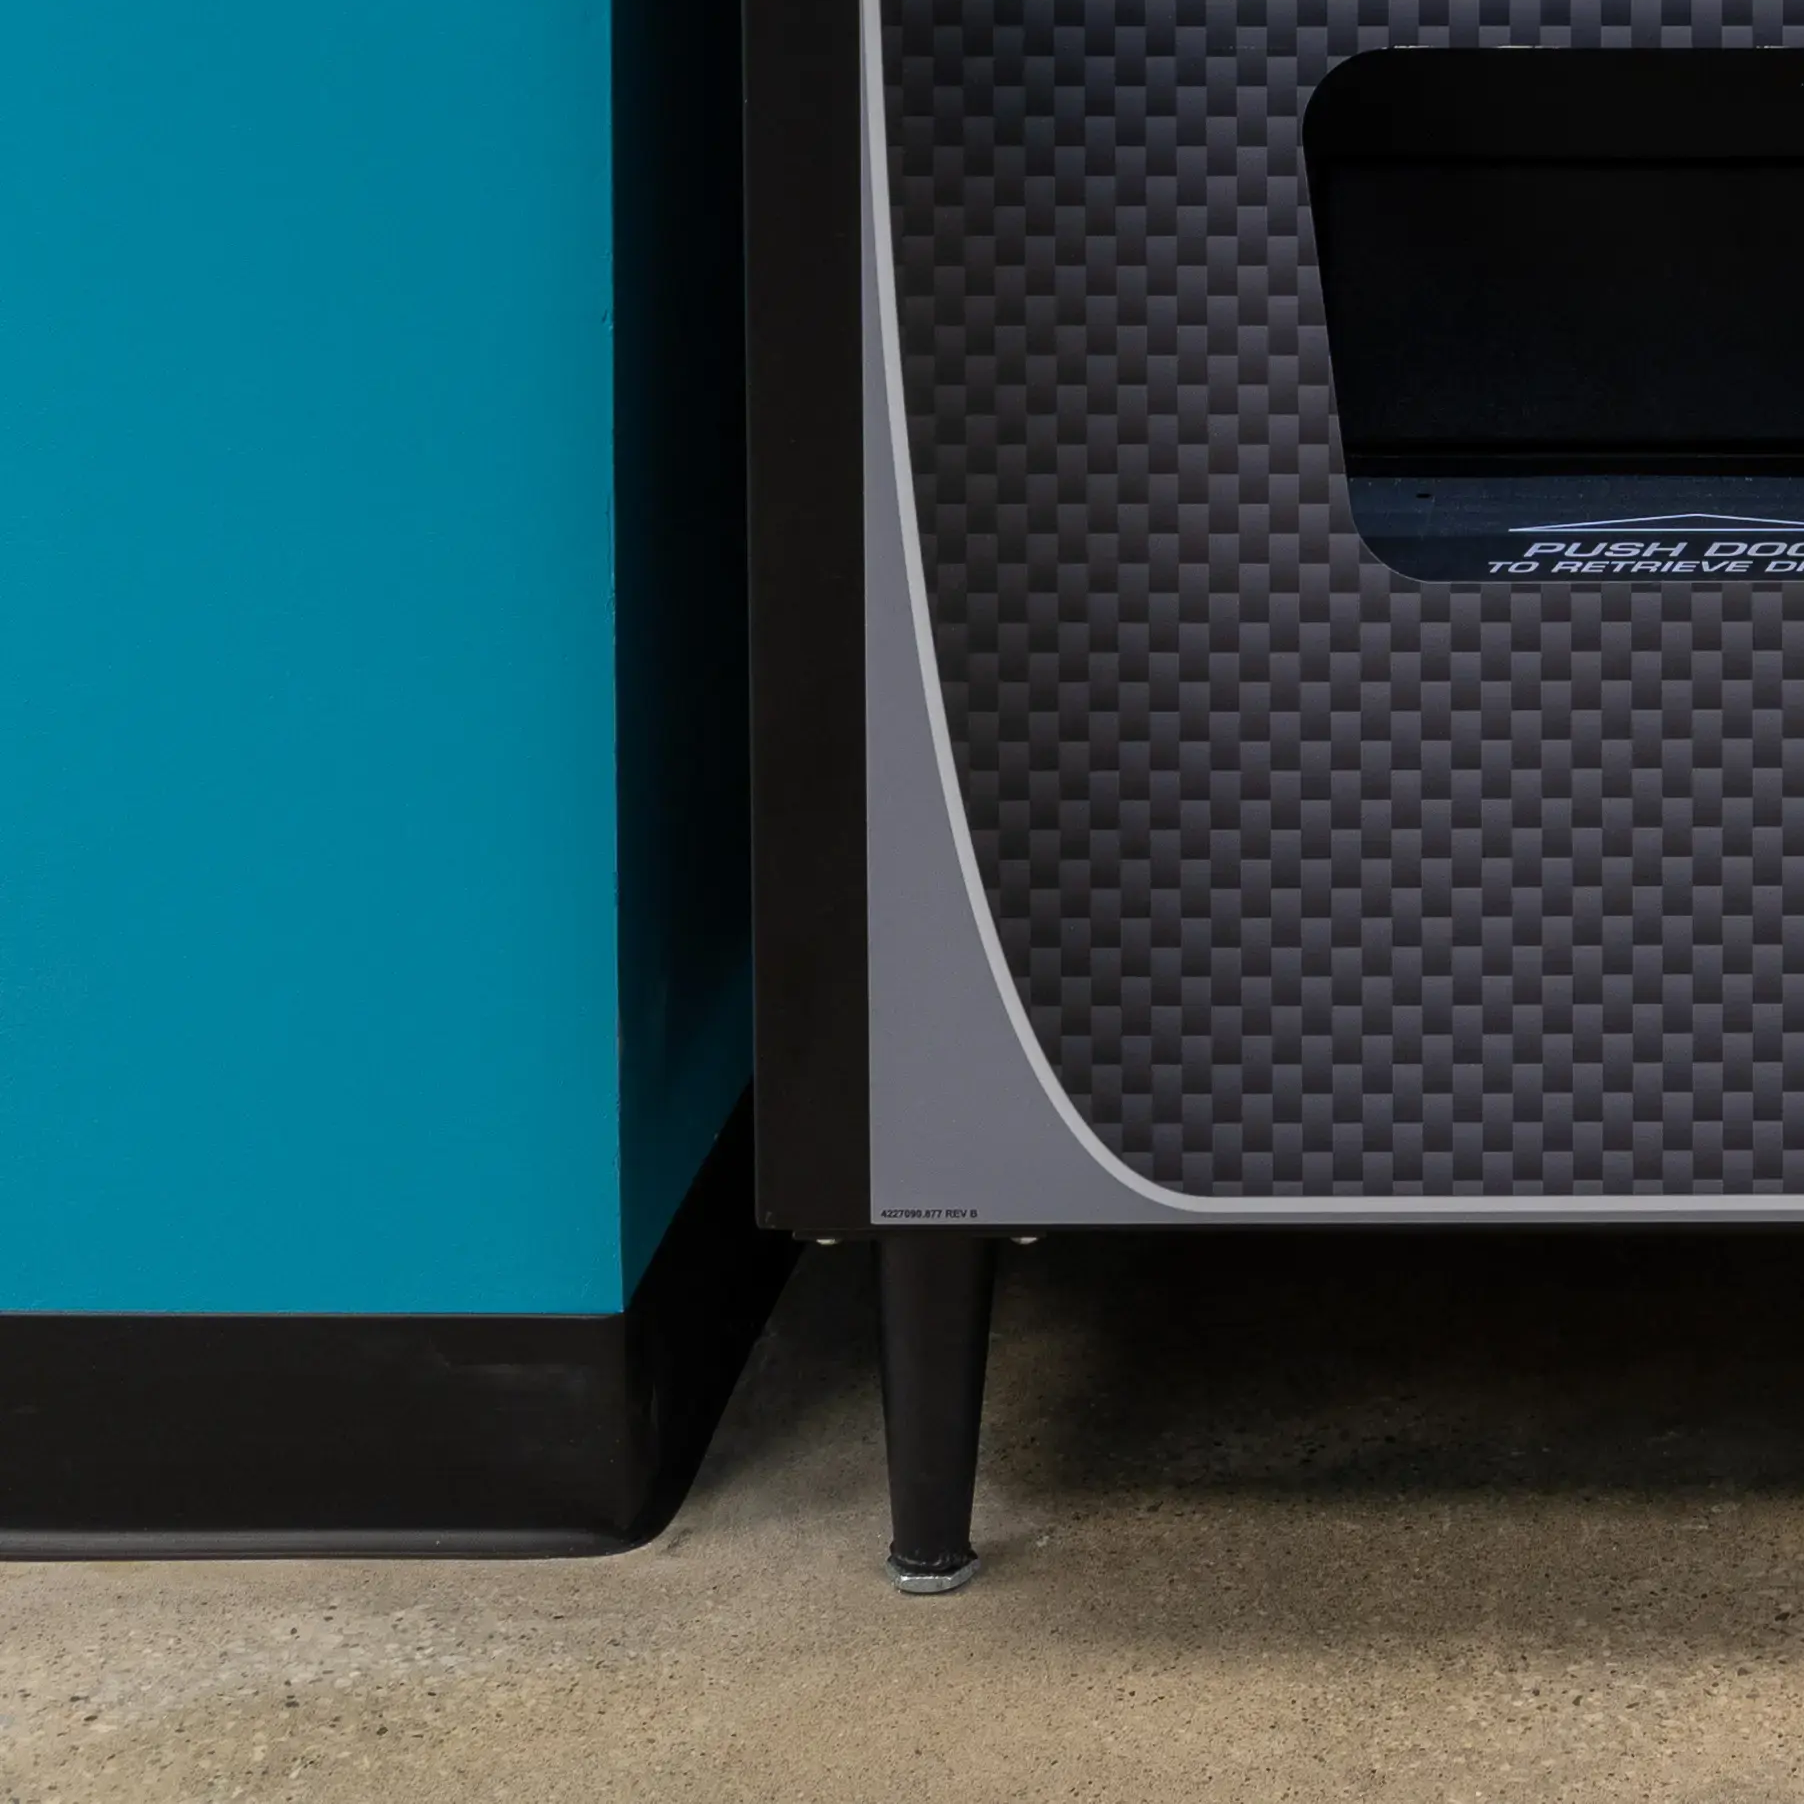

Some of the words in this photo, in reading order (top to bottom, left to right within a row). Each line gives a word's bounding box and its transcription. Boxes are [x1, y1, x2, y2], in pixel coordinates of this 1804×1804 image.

[1523, 541, 1690, 558] PUSH
[1487, 560, 1540, 573] TO
[1551, 560, 1754, 573] RETRIEVE
[945, 1209, 968, 1218] REV
